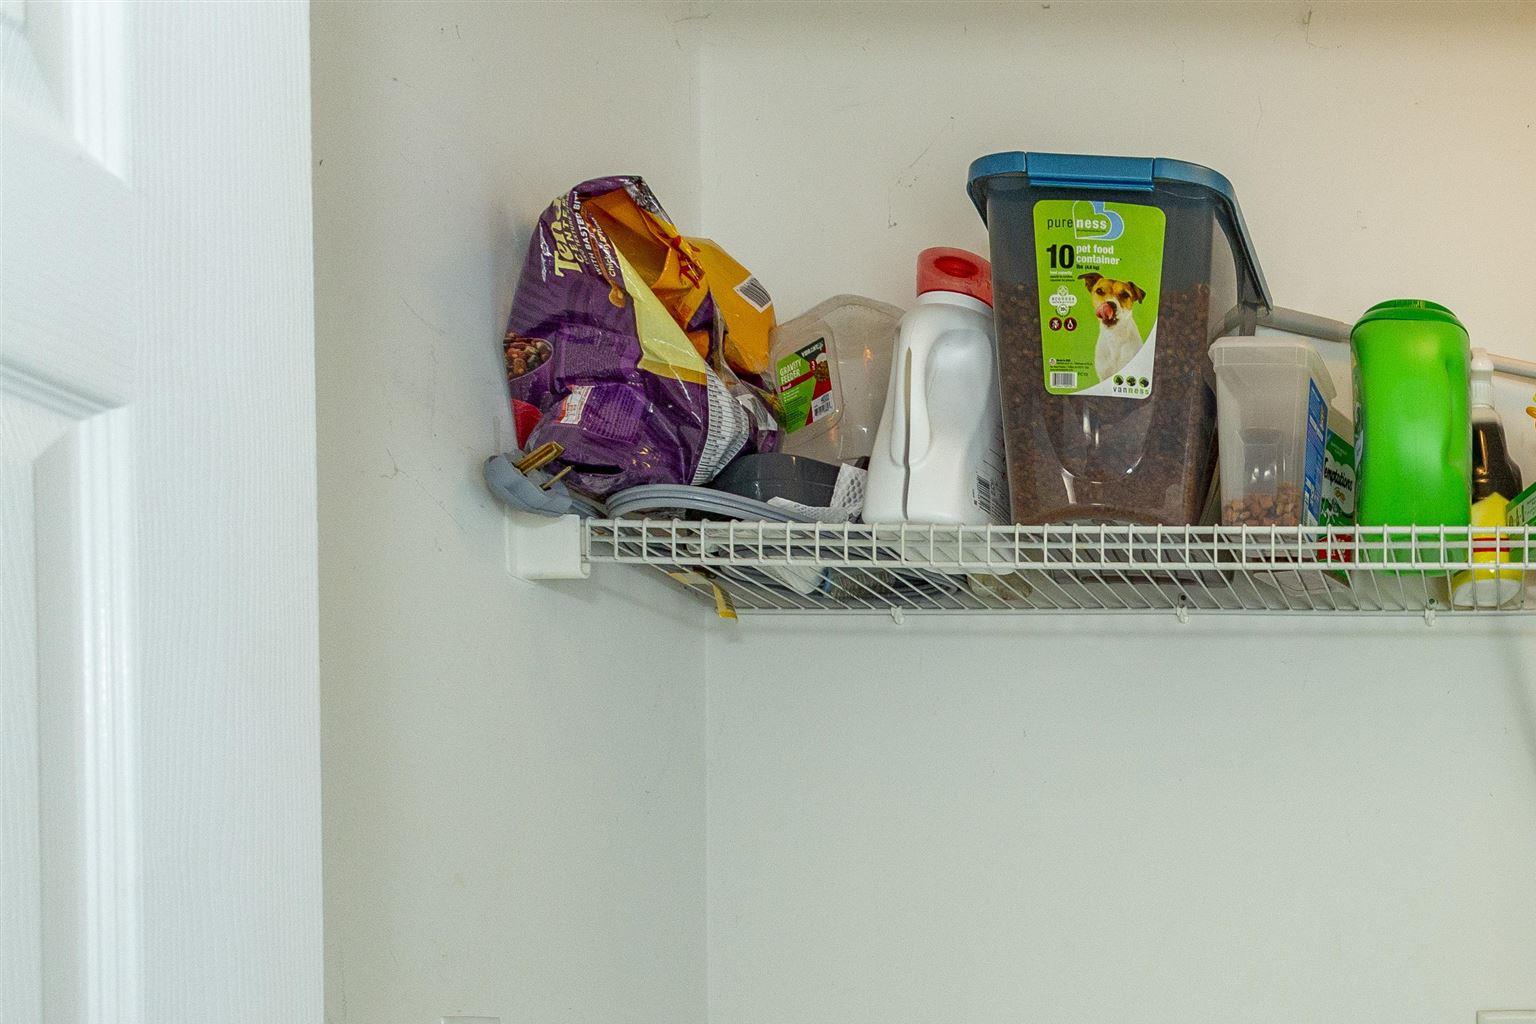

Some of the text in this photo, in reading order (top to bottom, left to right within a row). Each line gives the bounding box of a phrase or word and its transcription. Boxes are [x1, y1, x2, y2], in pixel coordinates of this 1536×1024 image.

[1046, 244, 1075, 269] 10
[1076, 244, 1114, 255] pet food
[780, 358, 802, 377] GRAVITY
[781, 368, 801, 385] FEEDER
